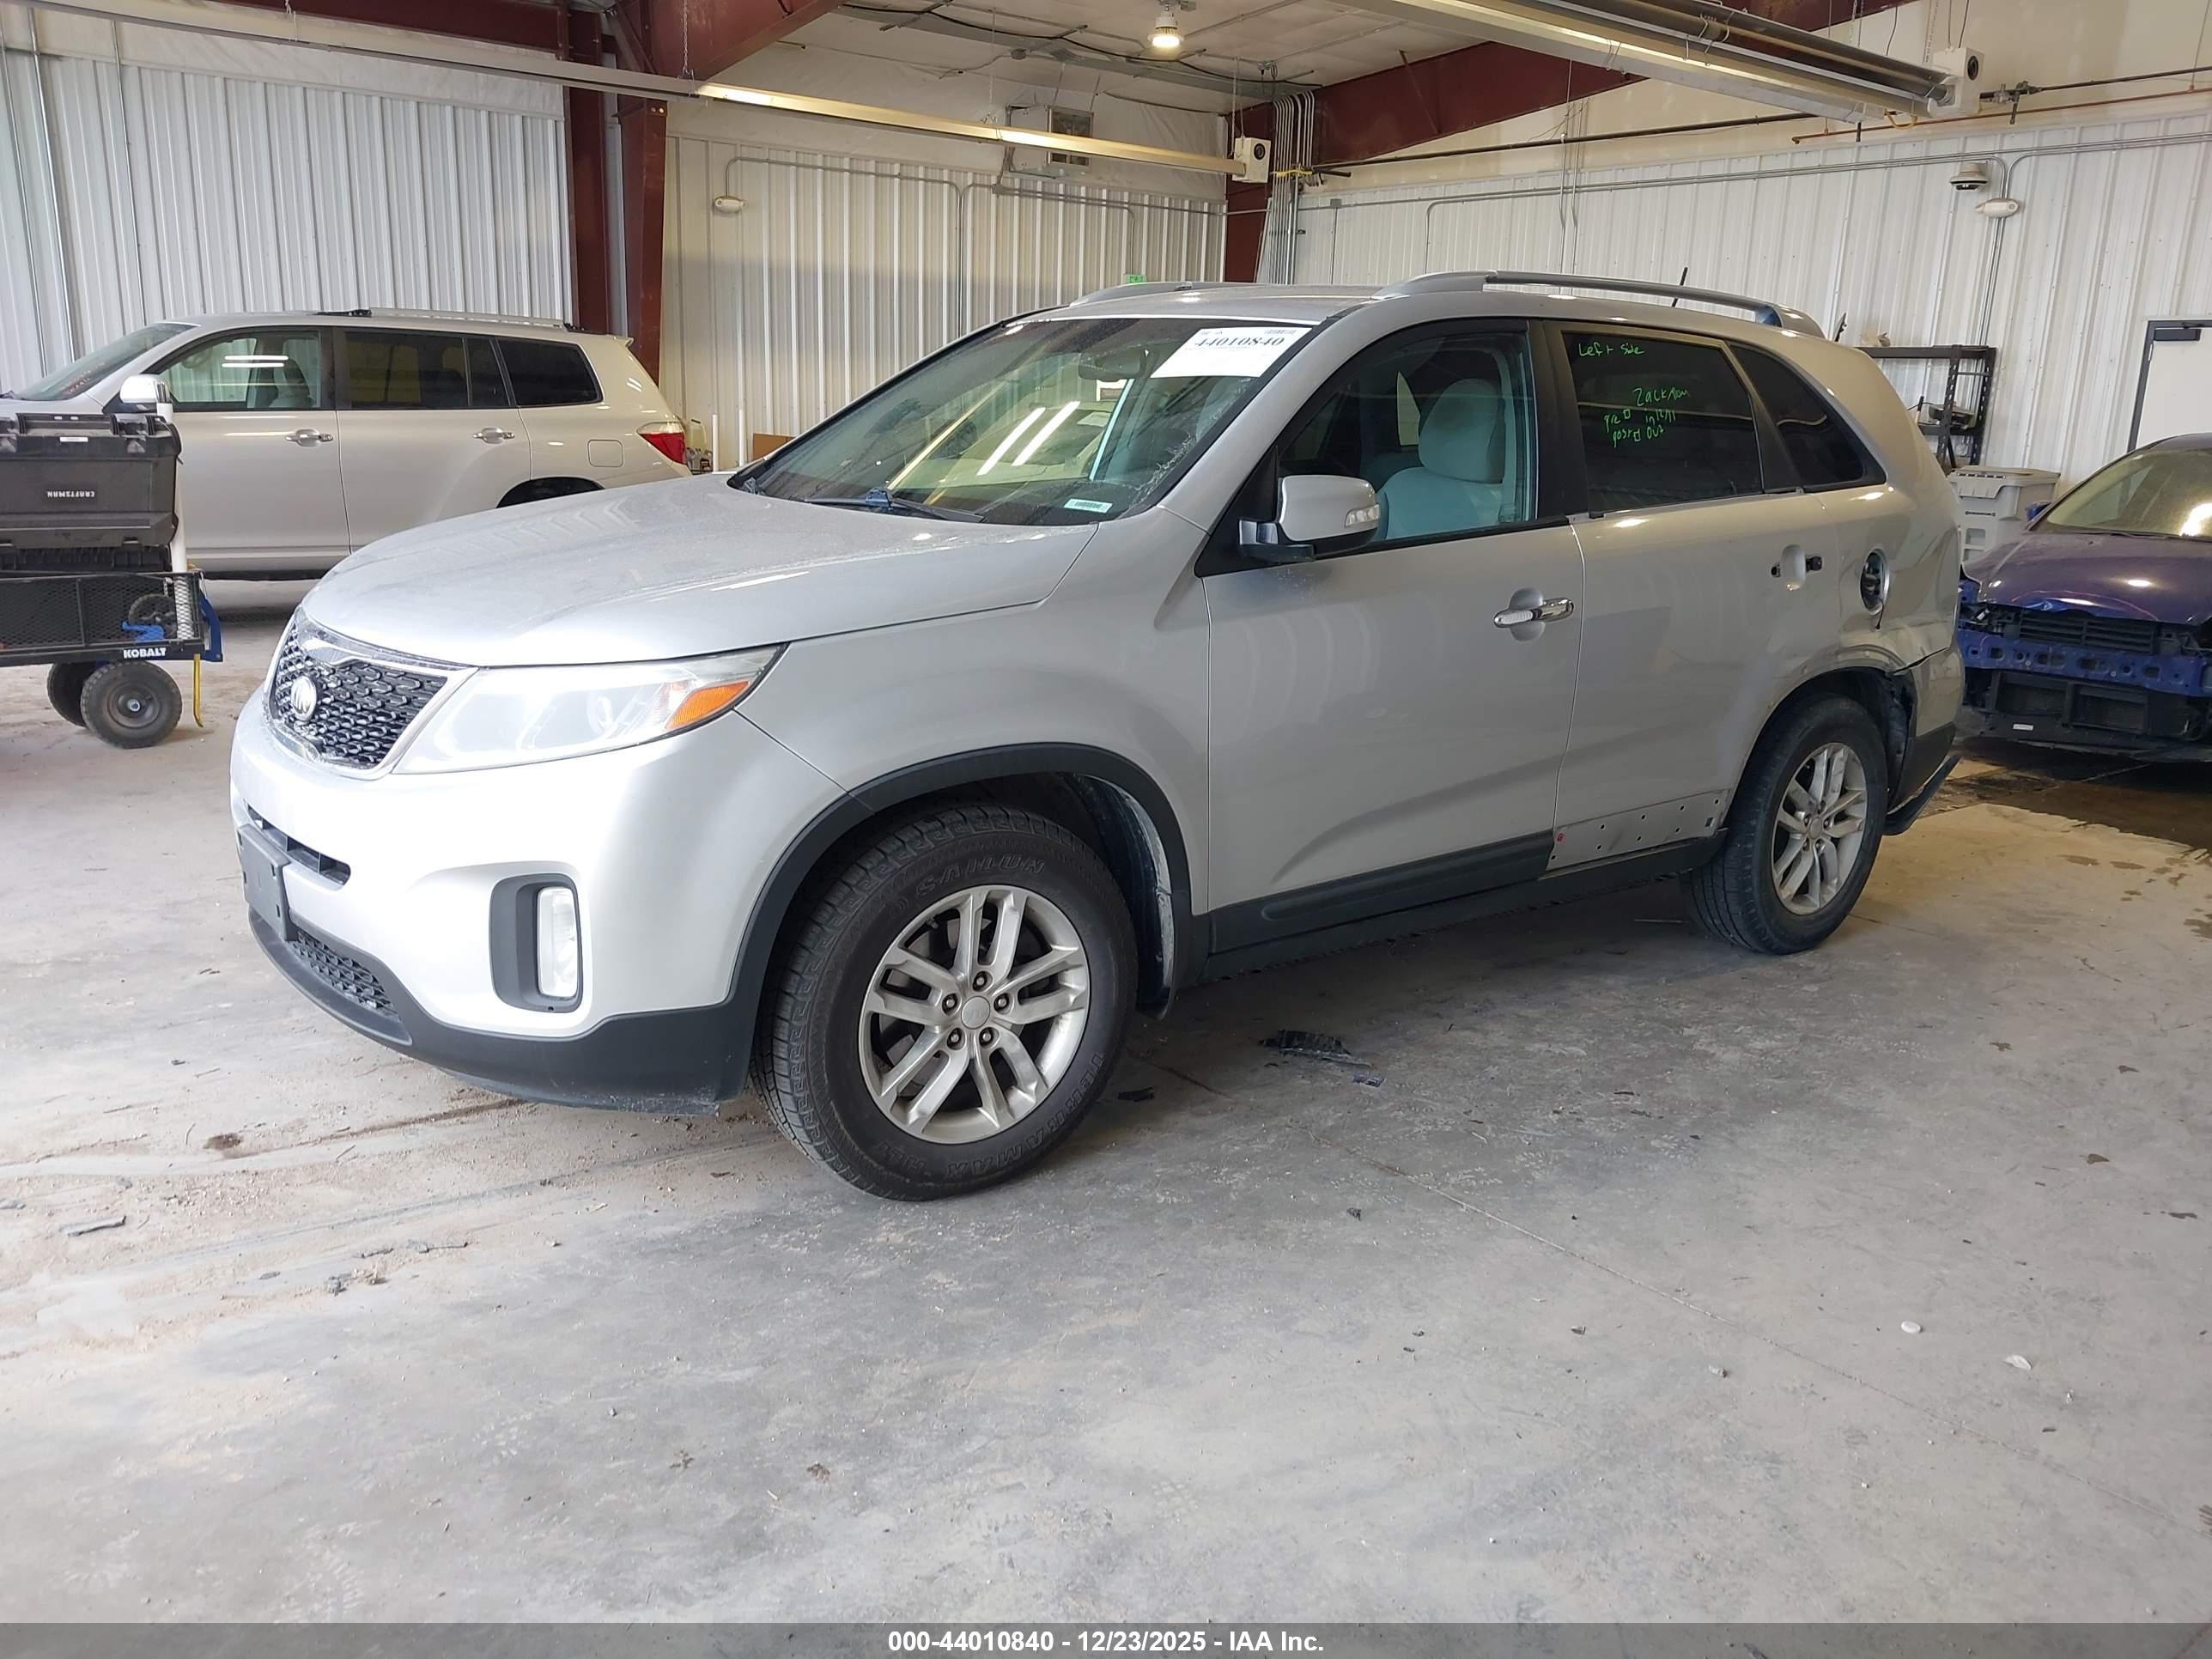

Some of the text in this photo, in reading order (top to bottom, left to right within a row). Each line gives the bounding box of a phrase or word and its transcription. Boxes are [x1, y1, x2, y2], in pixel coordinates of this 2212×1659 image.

[1194, 336, 1285, 347] 44010840
[123, 647, 167, 659] KOBALT
[916, 854, 1045, 896] SAILUN
